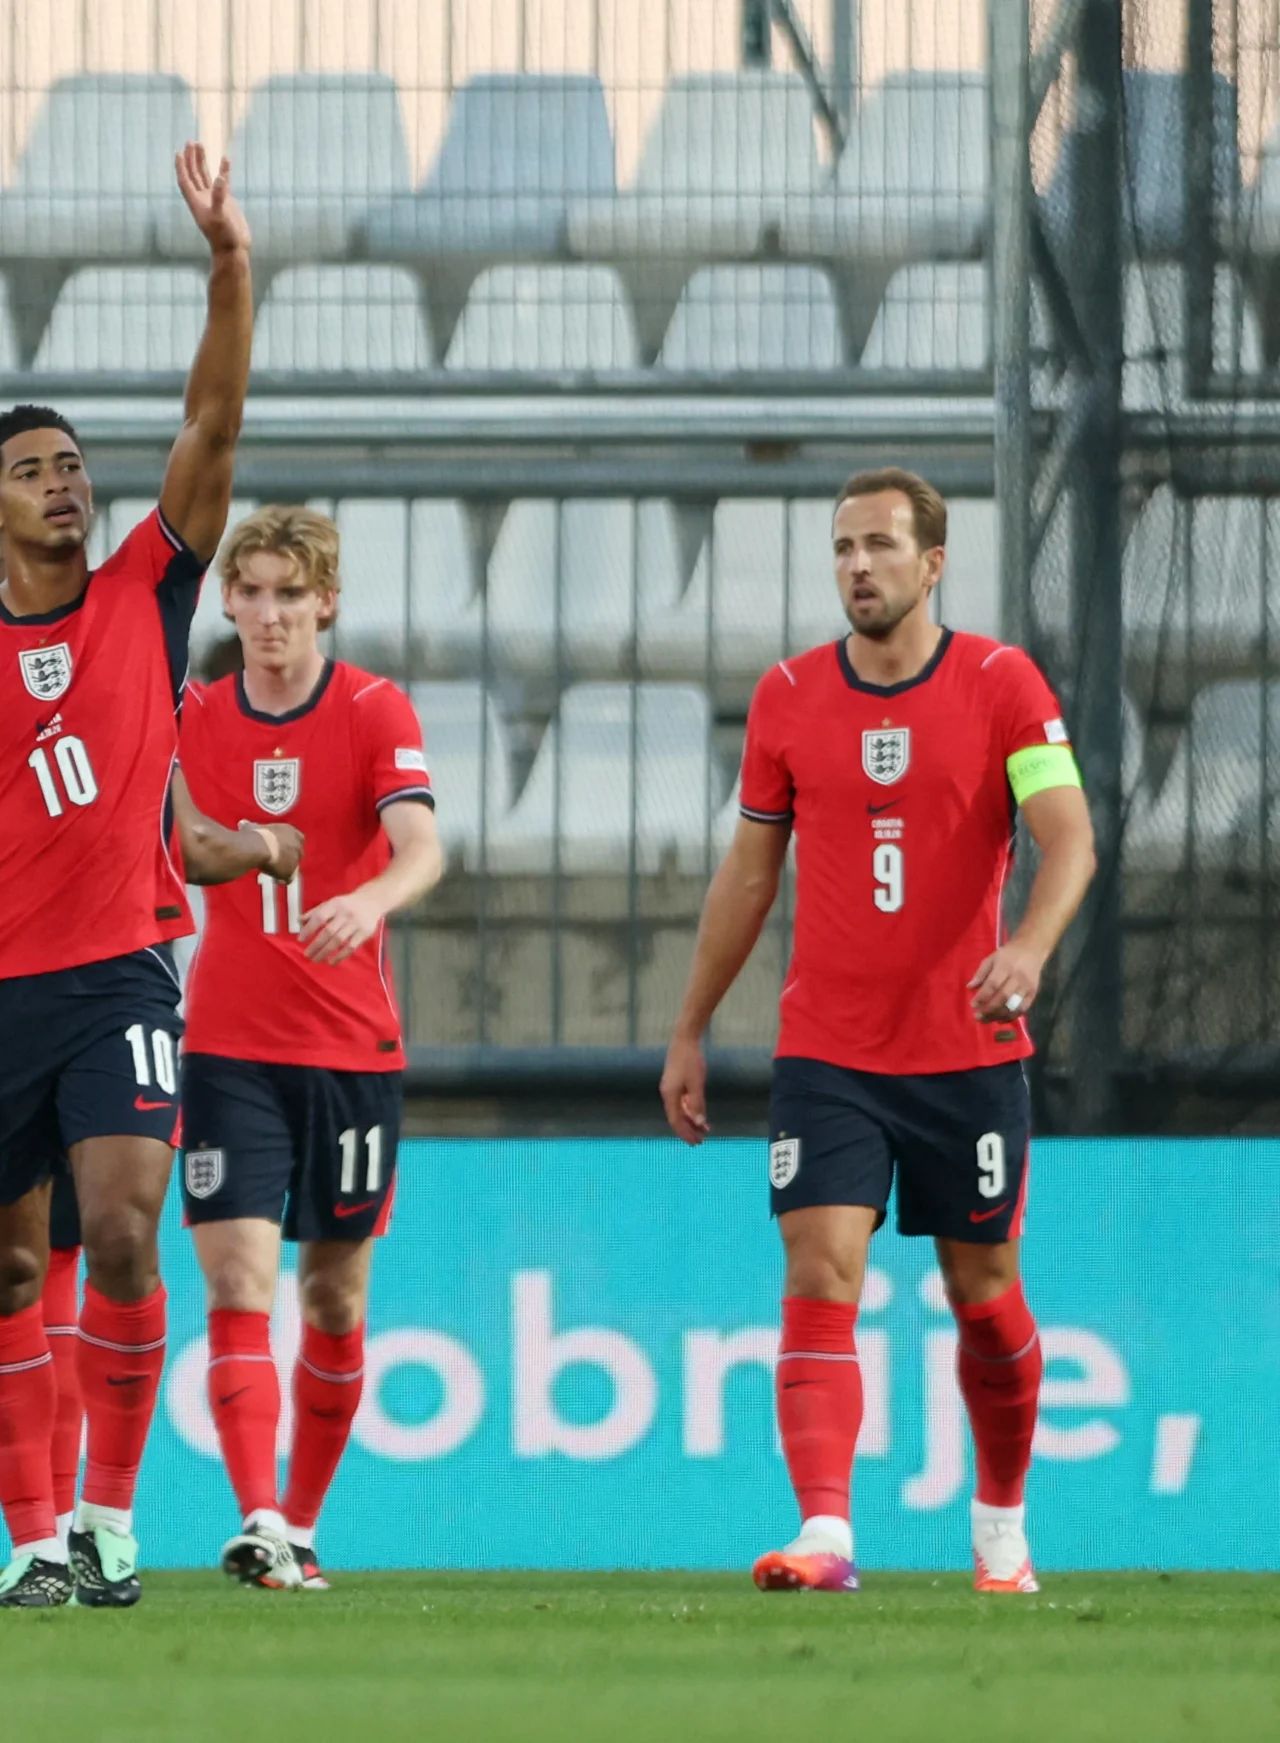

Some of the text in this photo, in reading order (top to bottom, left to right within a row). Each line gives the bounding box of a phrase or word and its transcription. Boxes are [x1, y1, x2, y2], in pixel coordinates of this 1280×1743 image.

[27, 735, 98, 818] 10
[257, 864, 302, 934] 11
[872, 843, 904, 913] 9
[125, 1023, 177, 1096] 10
[338, 1125, 382, 1194] 11
[976, 1131, 1006, 1199] 9
